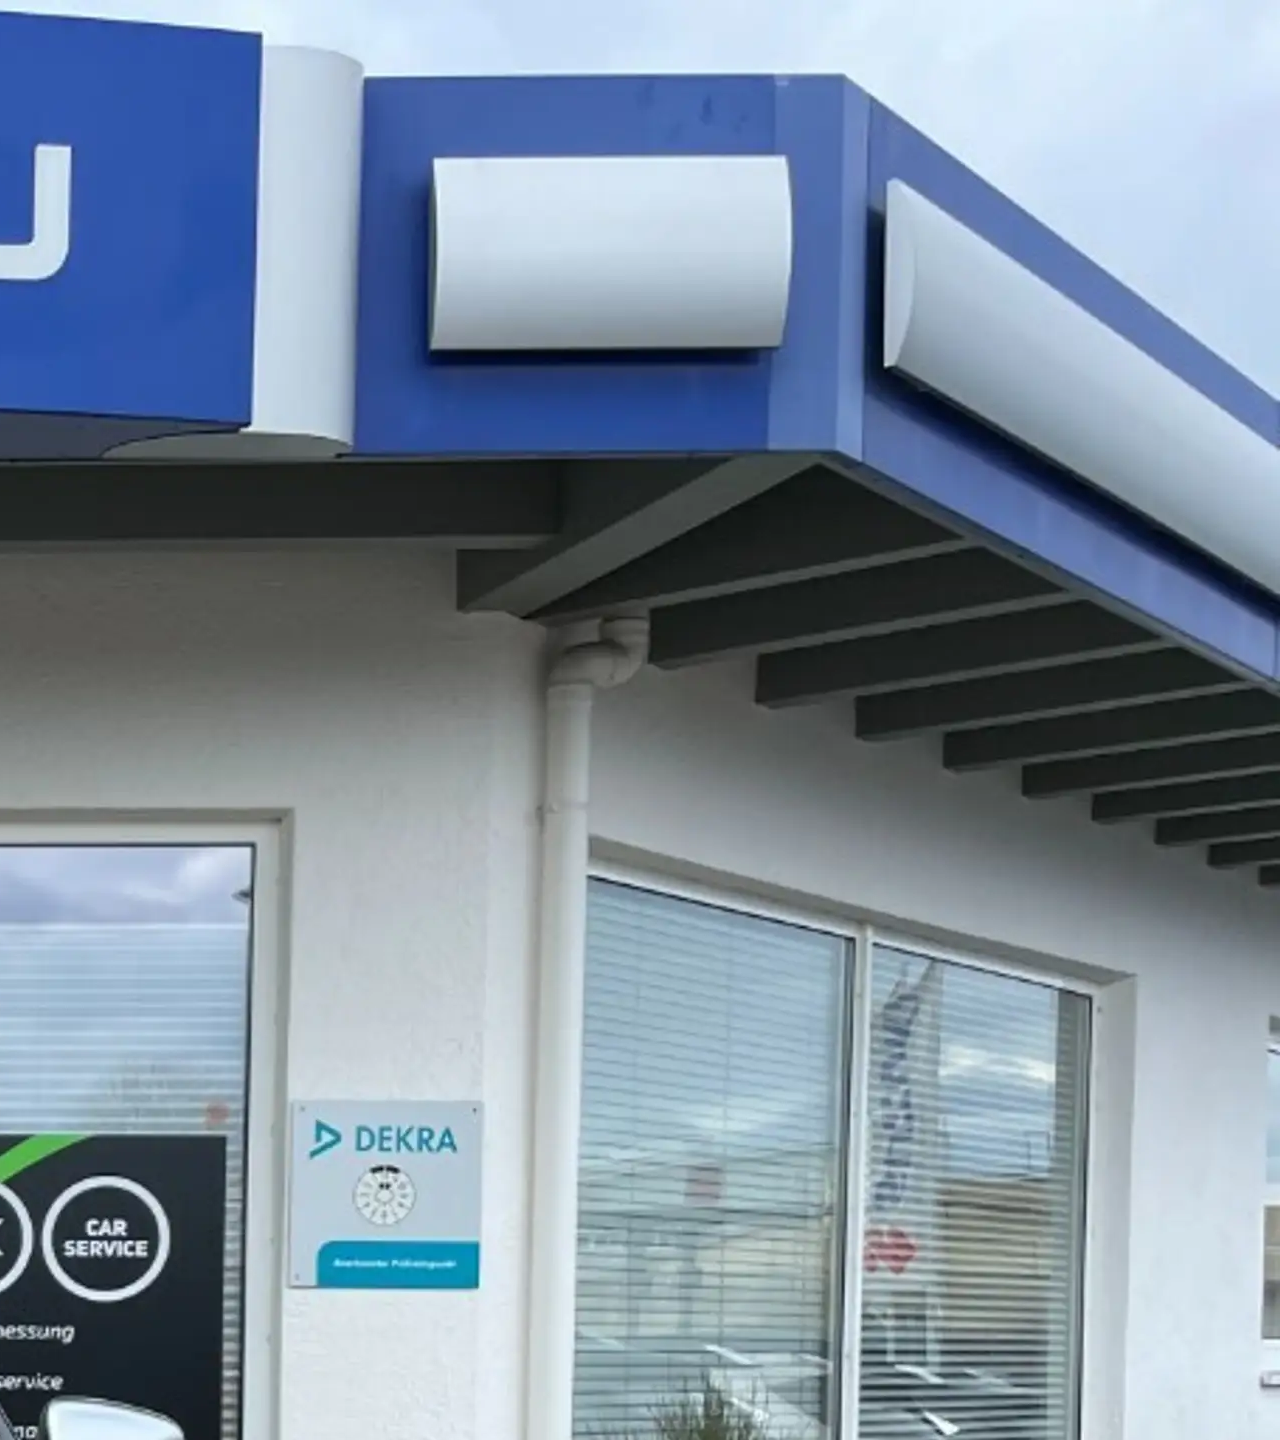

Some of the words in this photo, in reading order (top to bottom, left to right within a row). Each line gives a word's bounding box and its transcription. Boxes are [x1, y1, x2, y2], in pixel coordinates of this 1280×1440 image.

[355, 1125, 459, 1154] DEKRA
[85, 1219, 128, 1237] CAR
[63, 1239, 149, 1258] SERVICE
